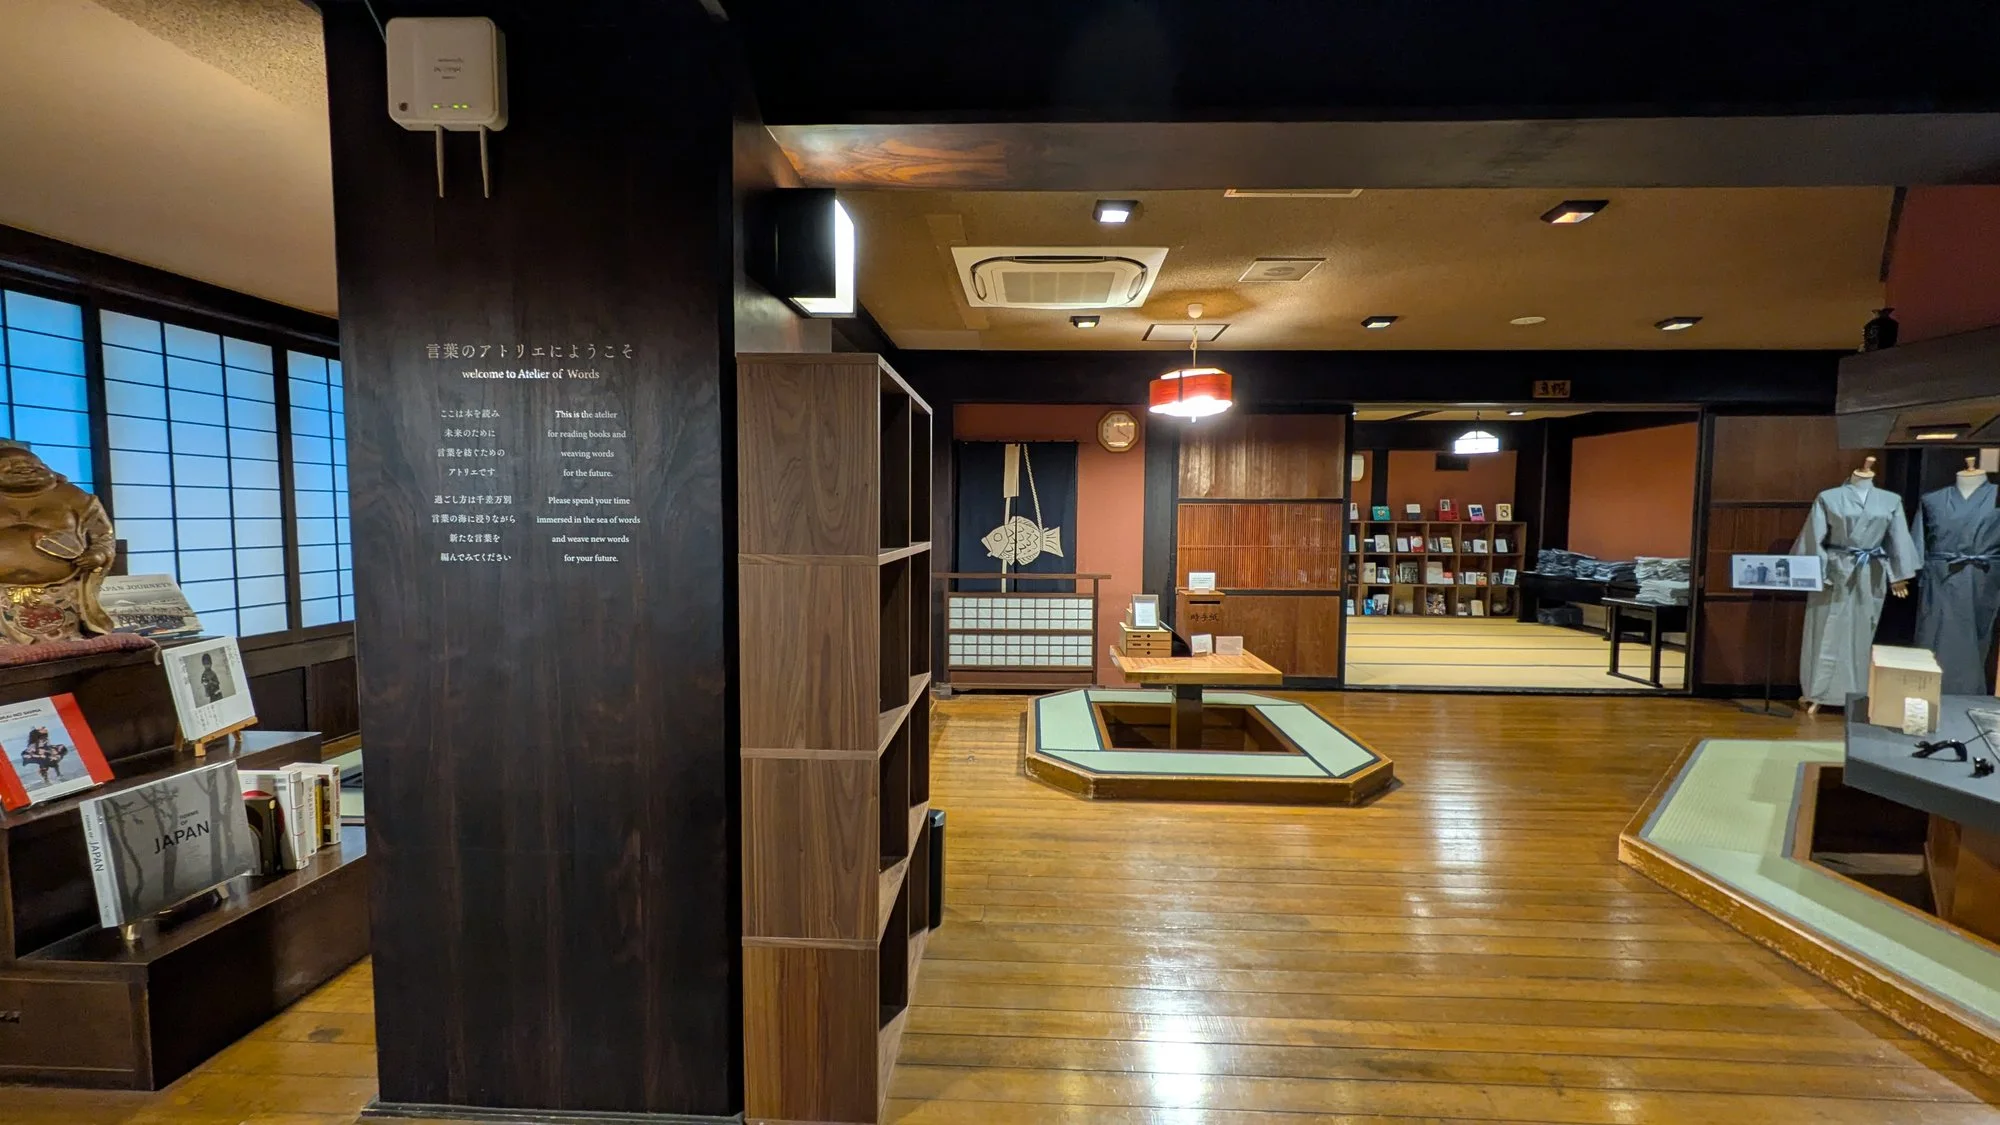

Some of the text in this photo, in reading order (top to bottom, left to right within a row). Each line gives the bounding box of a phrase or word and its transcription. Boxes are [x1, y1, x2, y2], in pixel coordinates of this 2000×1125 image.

[426, 343, 633, 359] 言葉のアトリエにようこそ
[462, 368, 600, 379] welcome to Atelier of Words
[441, 409, 500, 419] ここは本を読み
[555, 410, 618, 418] This is the atelier
[444, 429, 496, 438] 未来のために
[560, 430, 587, 440] reading
[437, 448, 505, 457] 言葉を紡ぐための
[561, 450, 590, 460] weaving
[448, 468, 495, 476] アトリエです
[434, 495, 512, 505] 過ごし方は千差万別
[548, 496, 630, 506] Please spend your time
[432, 514, 516, 524] 言葉の海に浸りながら
[450, 533, 500, 543] 新たな言葉を
[441, 552, 511, 562] 編んでみてください
[564, 554, 618, 564] for your future.
[154, 820, 210, 854] JAPAN
[88, 842, 104, 872] JAPAN
